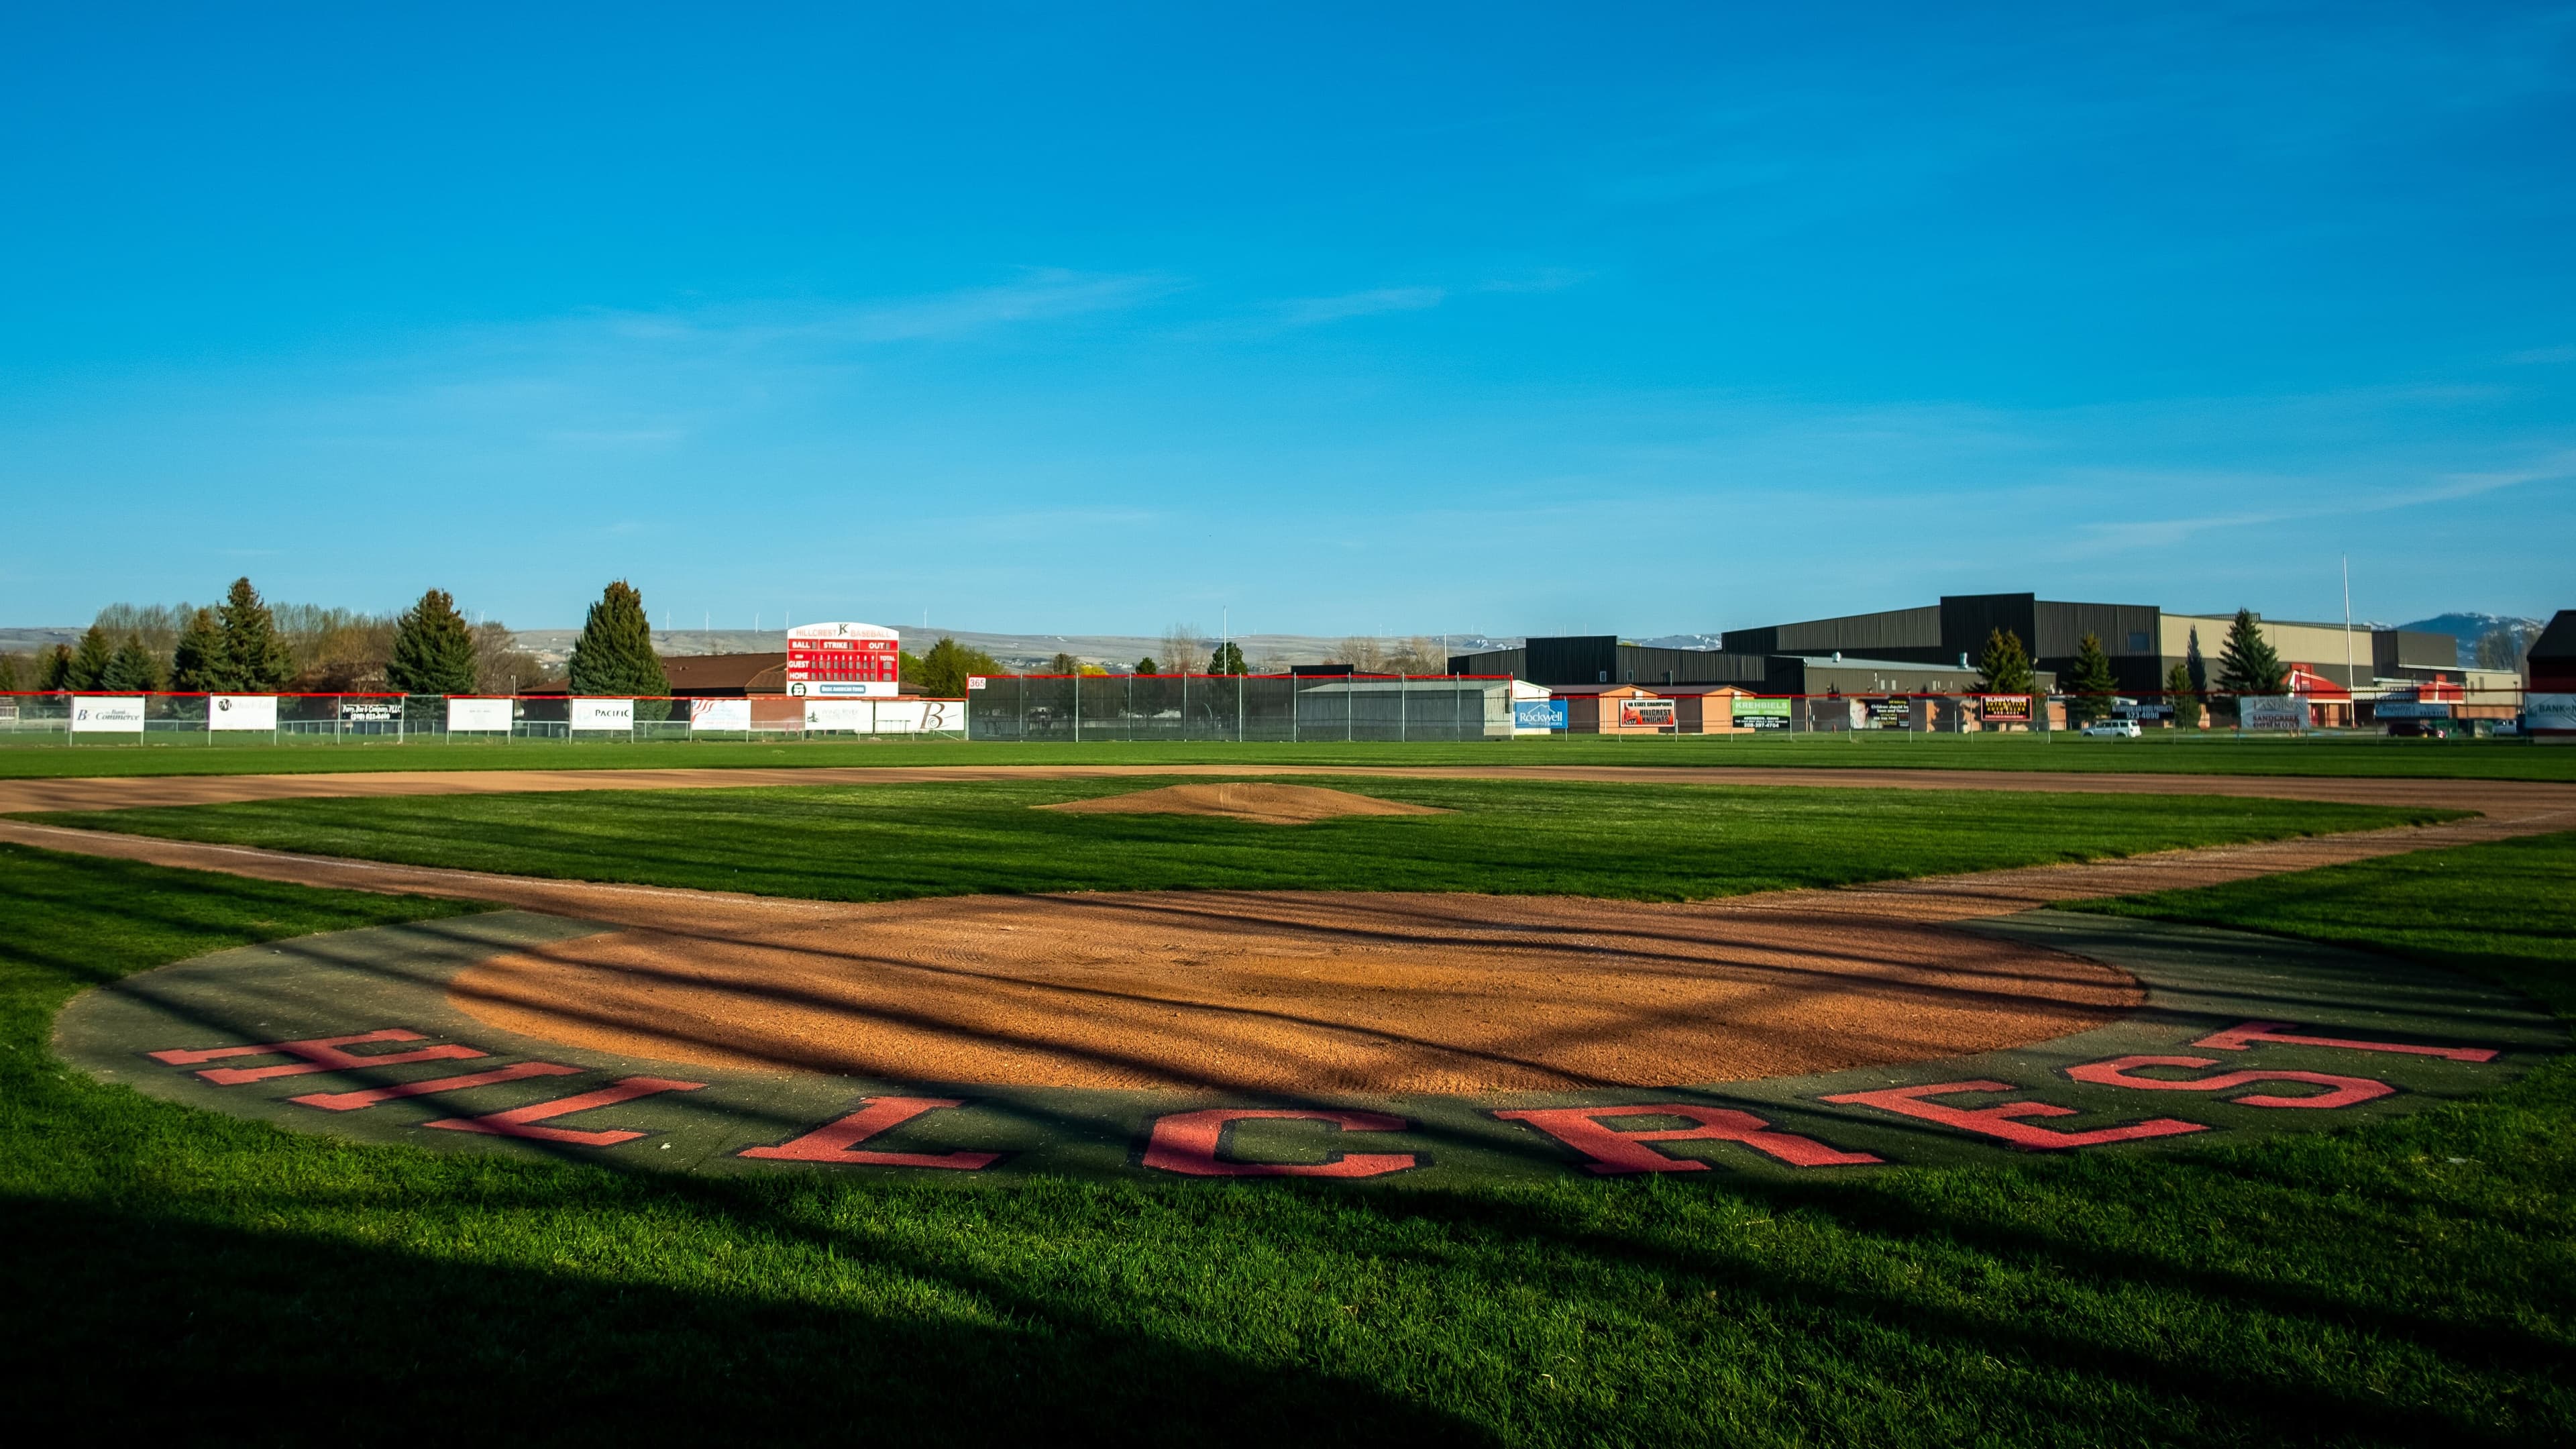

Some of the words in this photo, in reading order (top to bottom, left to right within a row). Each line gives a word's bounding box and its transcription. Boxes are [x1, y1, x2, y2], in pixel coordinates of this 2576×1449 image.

[970, 679, 985, 687] 365
[2539, 704, 2565, 713] BANK
[96, 712, 140, 720] Commerce
[596, 709, 629, 717] PACIFIC
[1520, 711, 1562, 722] Rockwell
[146, 1020, 2501, 1179] HILLCREST
